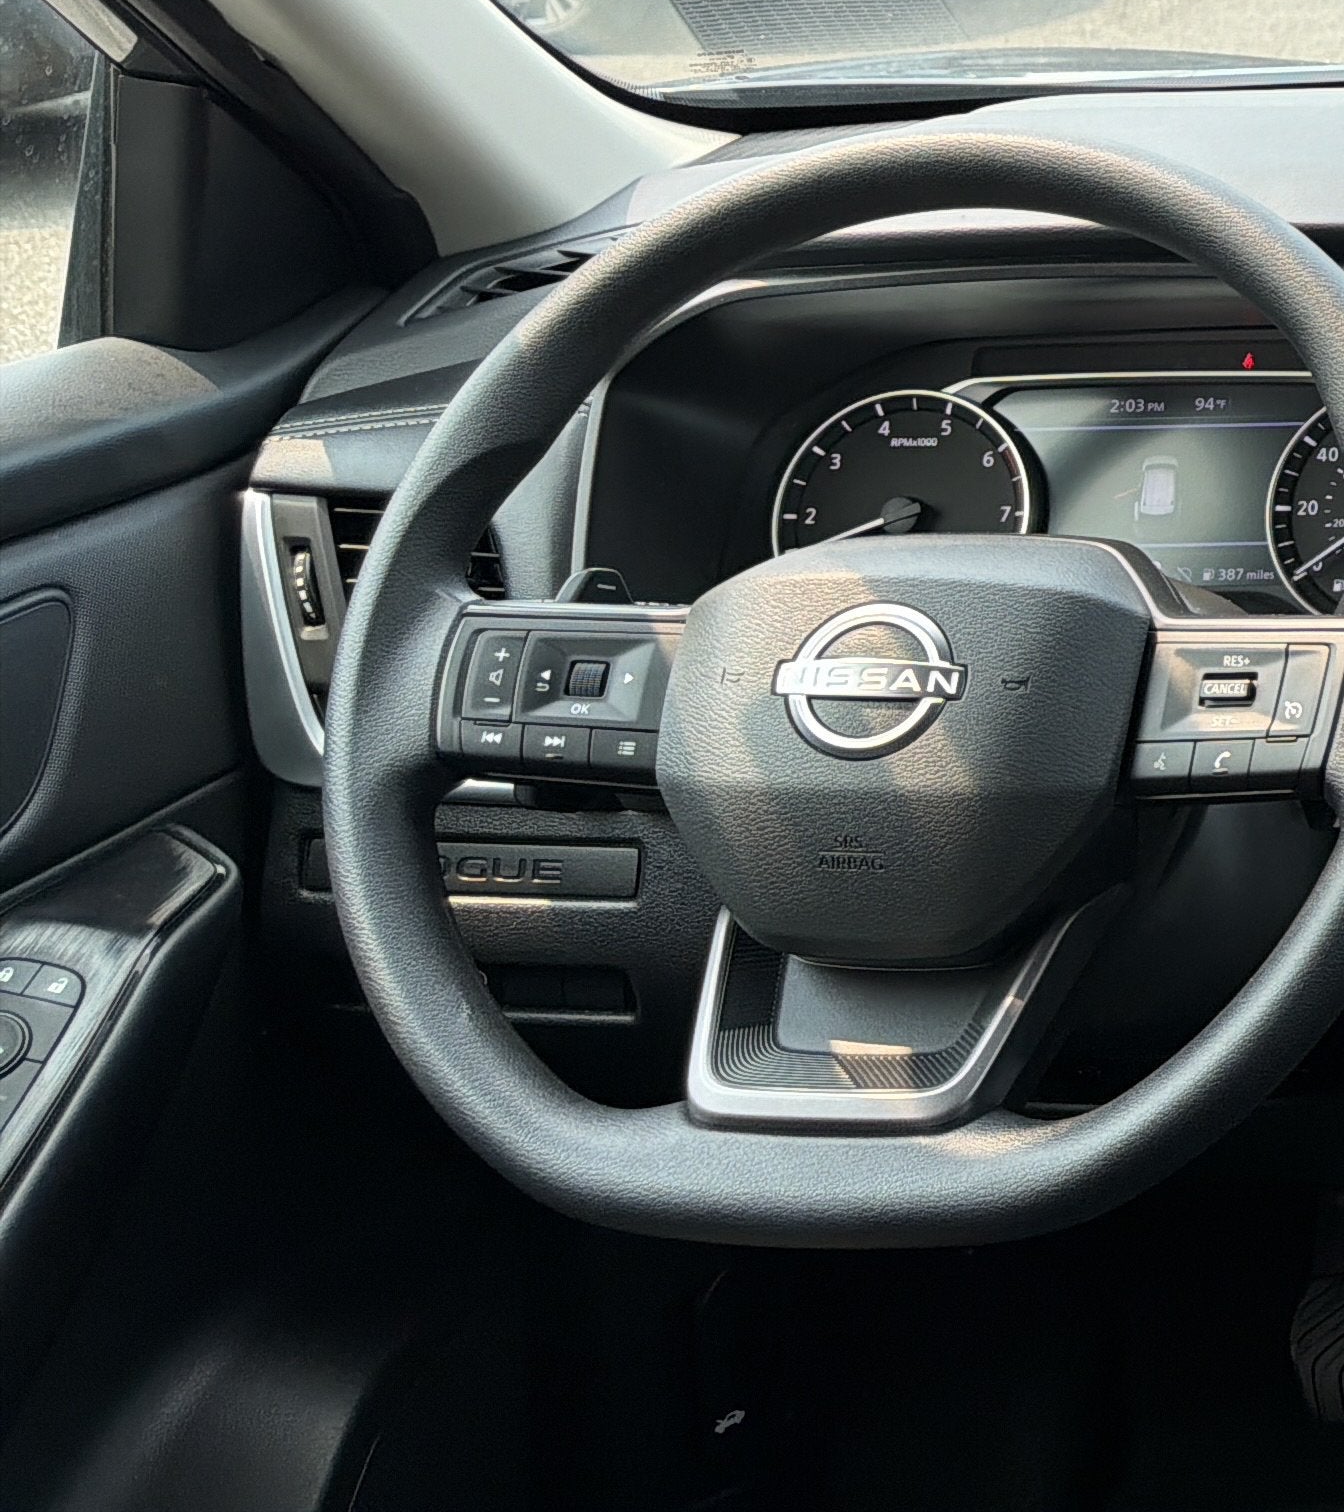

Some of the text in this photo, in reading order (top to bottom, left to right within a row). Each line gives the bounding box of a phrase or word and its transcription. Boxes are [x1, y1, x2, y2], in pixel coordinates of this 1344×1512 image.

[1109, 398, 1165, 413] 2:03 PM
[878, 420, 890, 436] 4
[940, 420, 952, 436] 5
[830, 453, 841, 470] 3
[982, 450, 994, 468] 6
[1316, 447, 1339, 462] 40
[1000, 506, 1012, 523] 7
[1296, 500, 1319, 516] 20
[804, 508, 817, 525] 2
[1218, 568, 1275, 580] 387 miles
[780, 664, 960, 695] NISSAN
[1204, 683, 1246, 694] CANCEL
[570, 702, 590, 716] OK
[819, 855, 884, 870] AIRBAG
